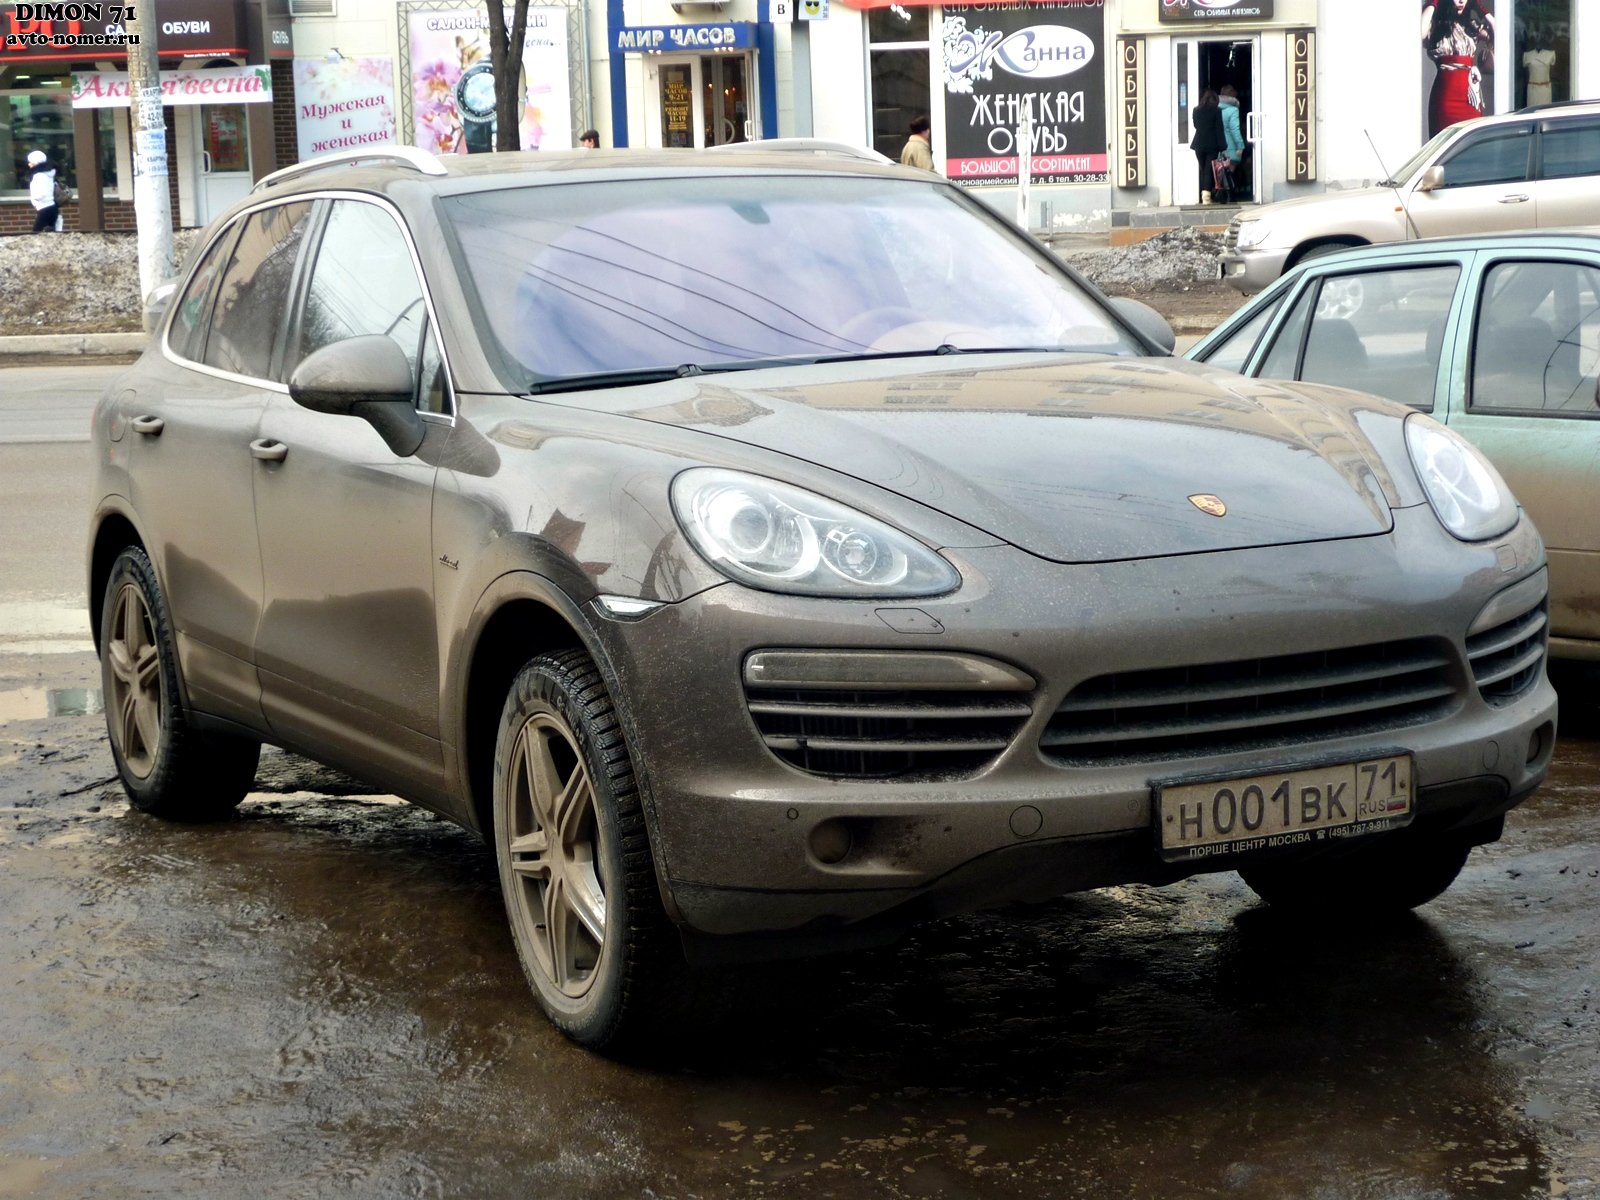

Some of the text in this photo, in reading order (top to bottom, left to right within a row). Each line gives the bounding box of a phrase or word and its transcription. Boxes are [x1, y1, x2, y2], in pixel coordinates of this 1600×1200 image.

[162, 21, 210, 35] ОБУВИ
[618, 27, 737, 48] МИР ЧАСОВ
[185, 73, 262, 94] весна
[301, 93, 385, 119] Мужская
[1125, 45, 1137, 182] ОБУВЬ
[1295, 38, 1308, 175] ОБУВЬ
[341, 119, 352, 130] и
[312, 128, 389, 152] женская
[960, 158, 1016, 174] БОЛЬШОЙ
[1049, 175, 1054, 183] 6
[1073, 174, 1109, 183] 30-28-33
[1361, 761, 1398, 800] 71
[1359, 799, 1386, 816] RUS
[1189, 819, 1391, 858] ПОРШЕ ЦЕНТР МОСКВА (495) 787-9-911
